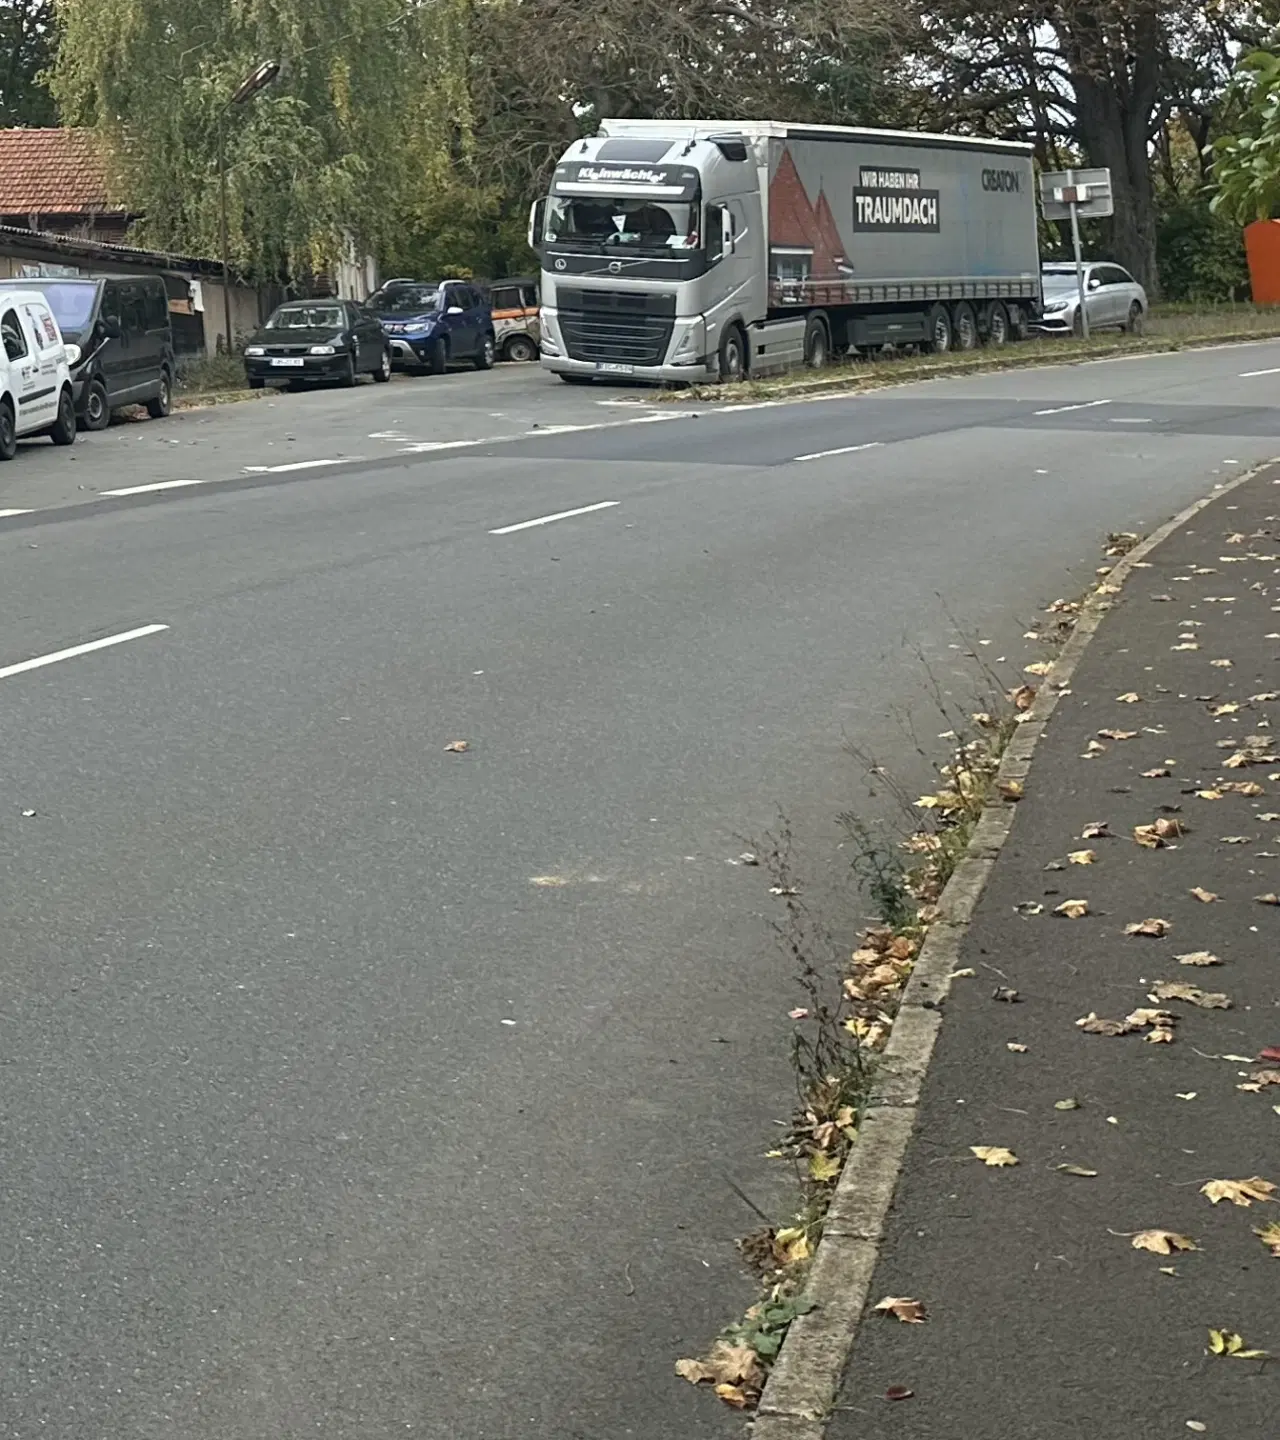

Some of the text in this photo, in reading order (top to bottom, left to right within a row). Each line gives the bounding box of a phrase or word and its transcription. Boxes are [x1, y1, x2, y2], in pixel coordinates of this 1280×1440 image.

[578, 167, 667, 184] Kleinwächter
[860, 170, 919, 190] WIR HABEN IHR
[981, 168, 1020, 194] CREATON
[855, 195, 937, 225] TRAUMDACH
